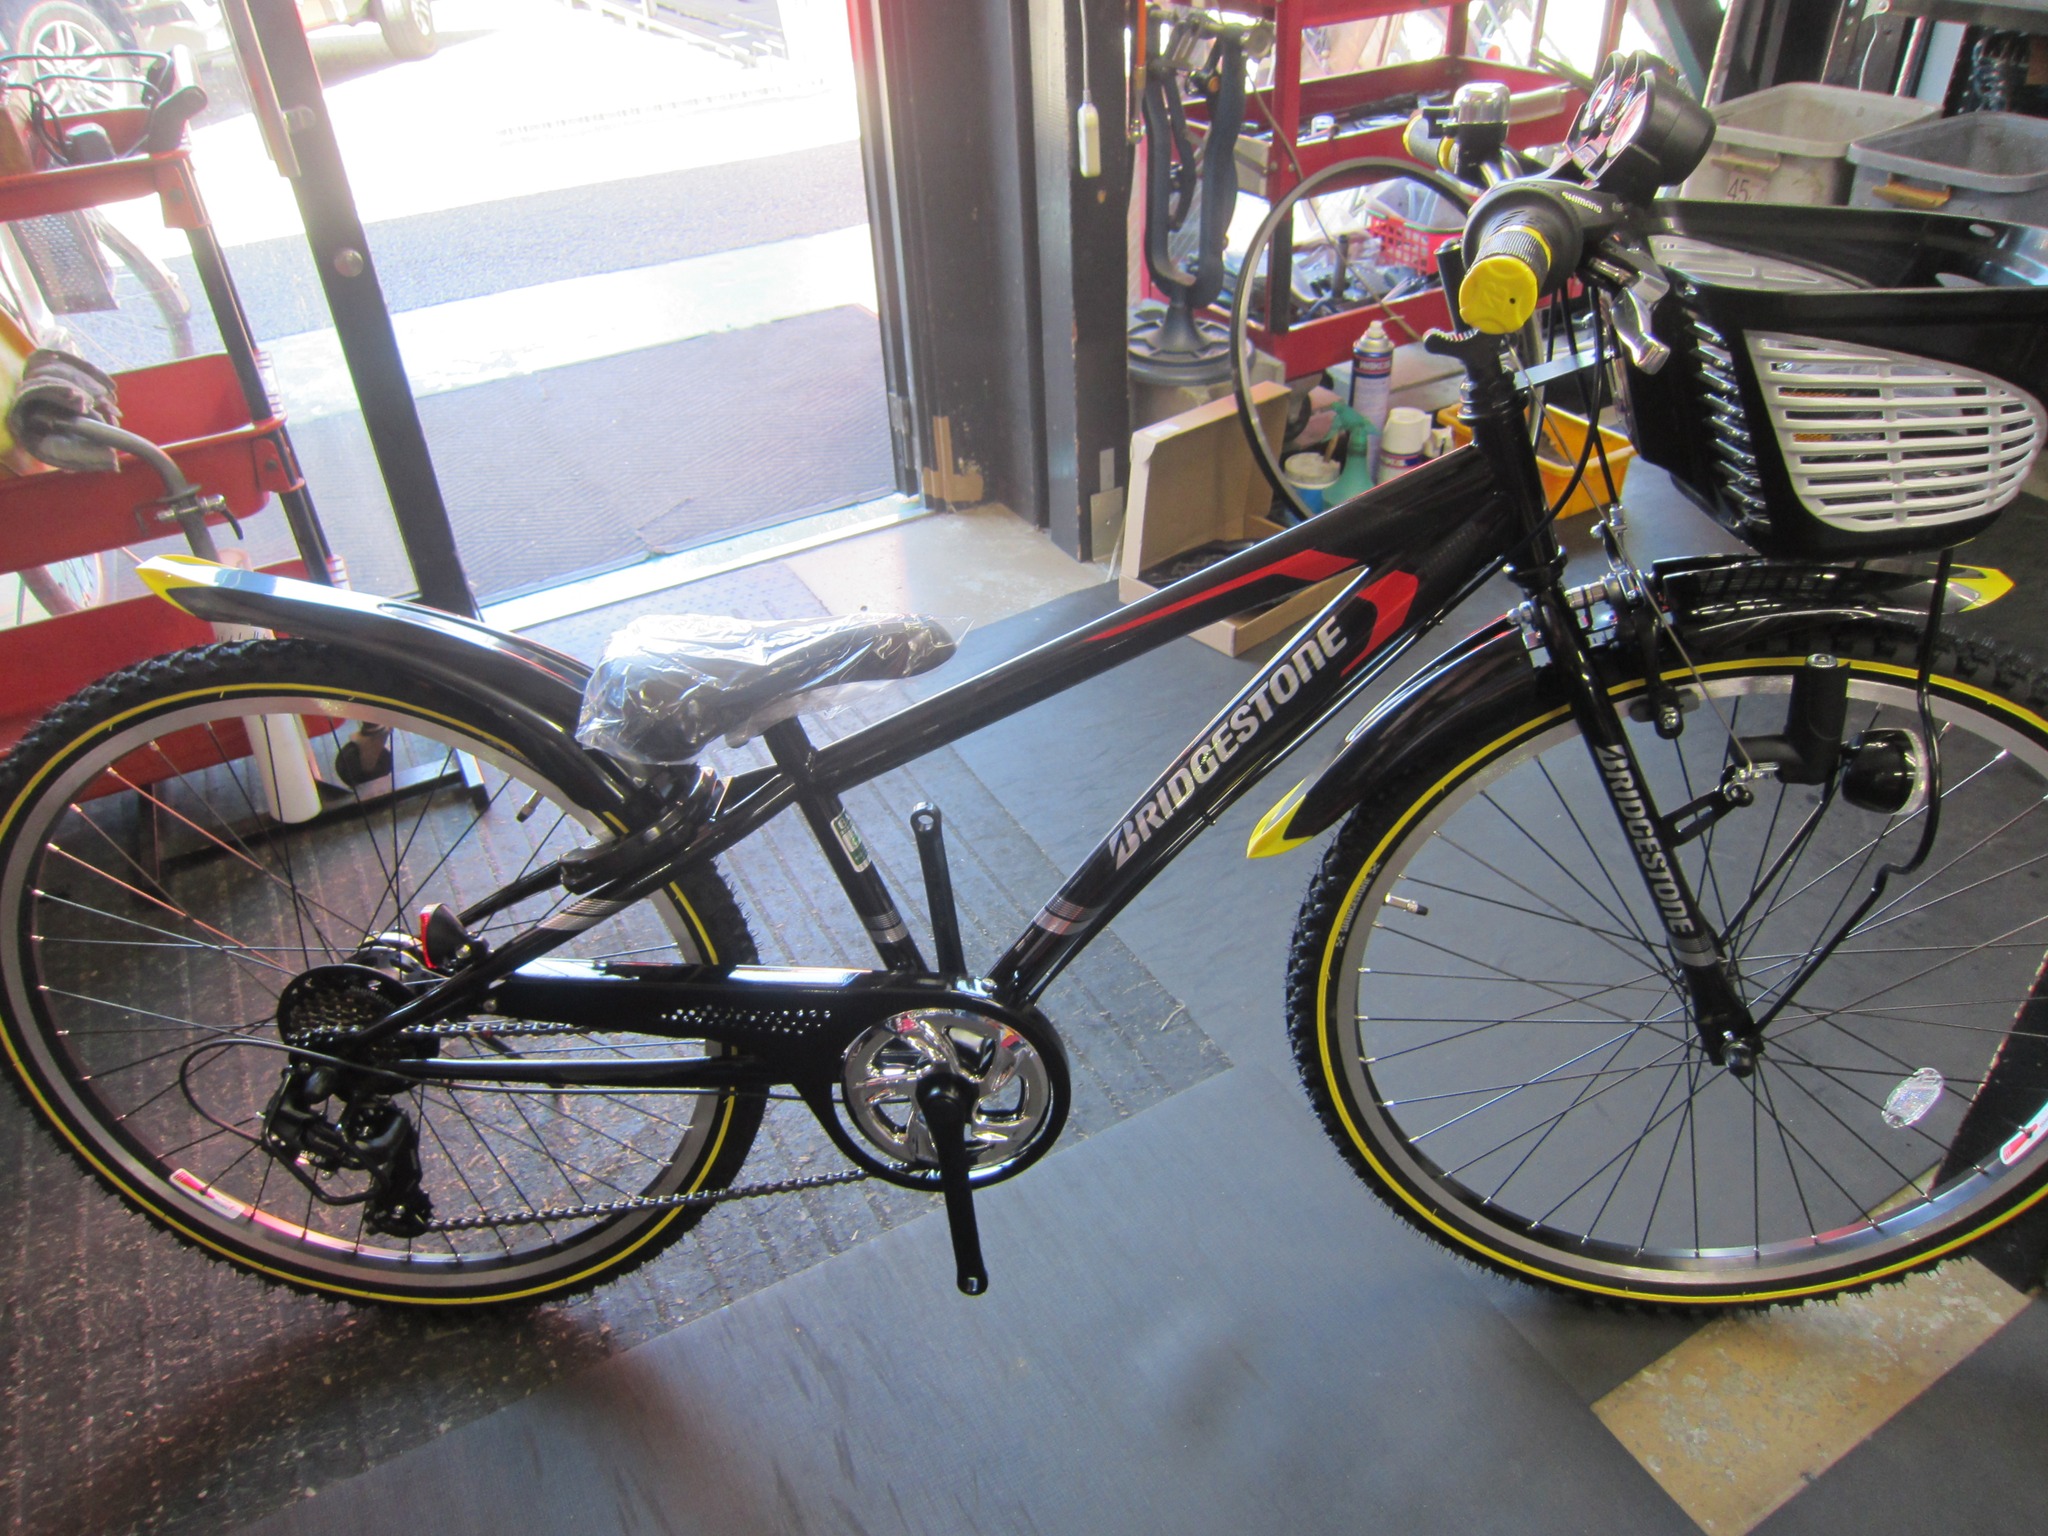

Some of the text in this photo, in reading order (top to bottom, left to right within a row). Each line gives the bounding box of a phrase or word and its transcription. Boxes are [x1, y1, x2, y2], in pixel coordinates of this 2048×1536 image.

[1562, 191, 1602, 213] SHIMANO
[1108, 615, 1347, 870] BRIDGESTONE
[1595, 744, 1695, 933] BRIDGESTONE
